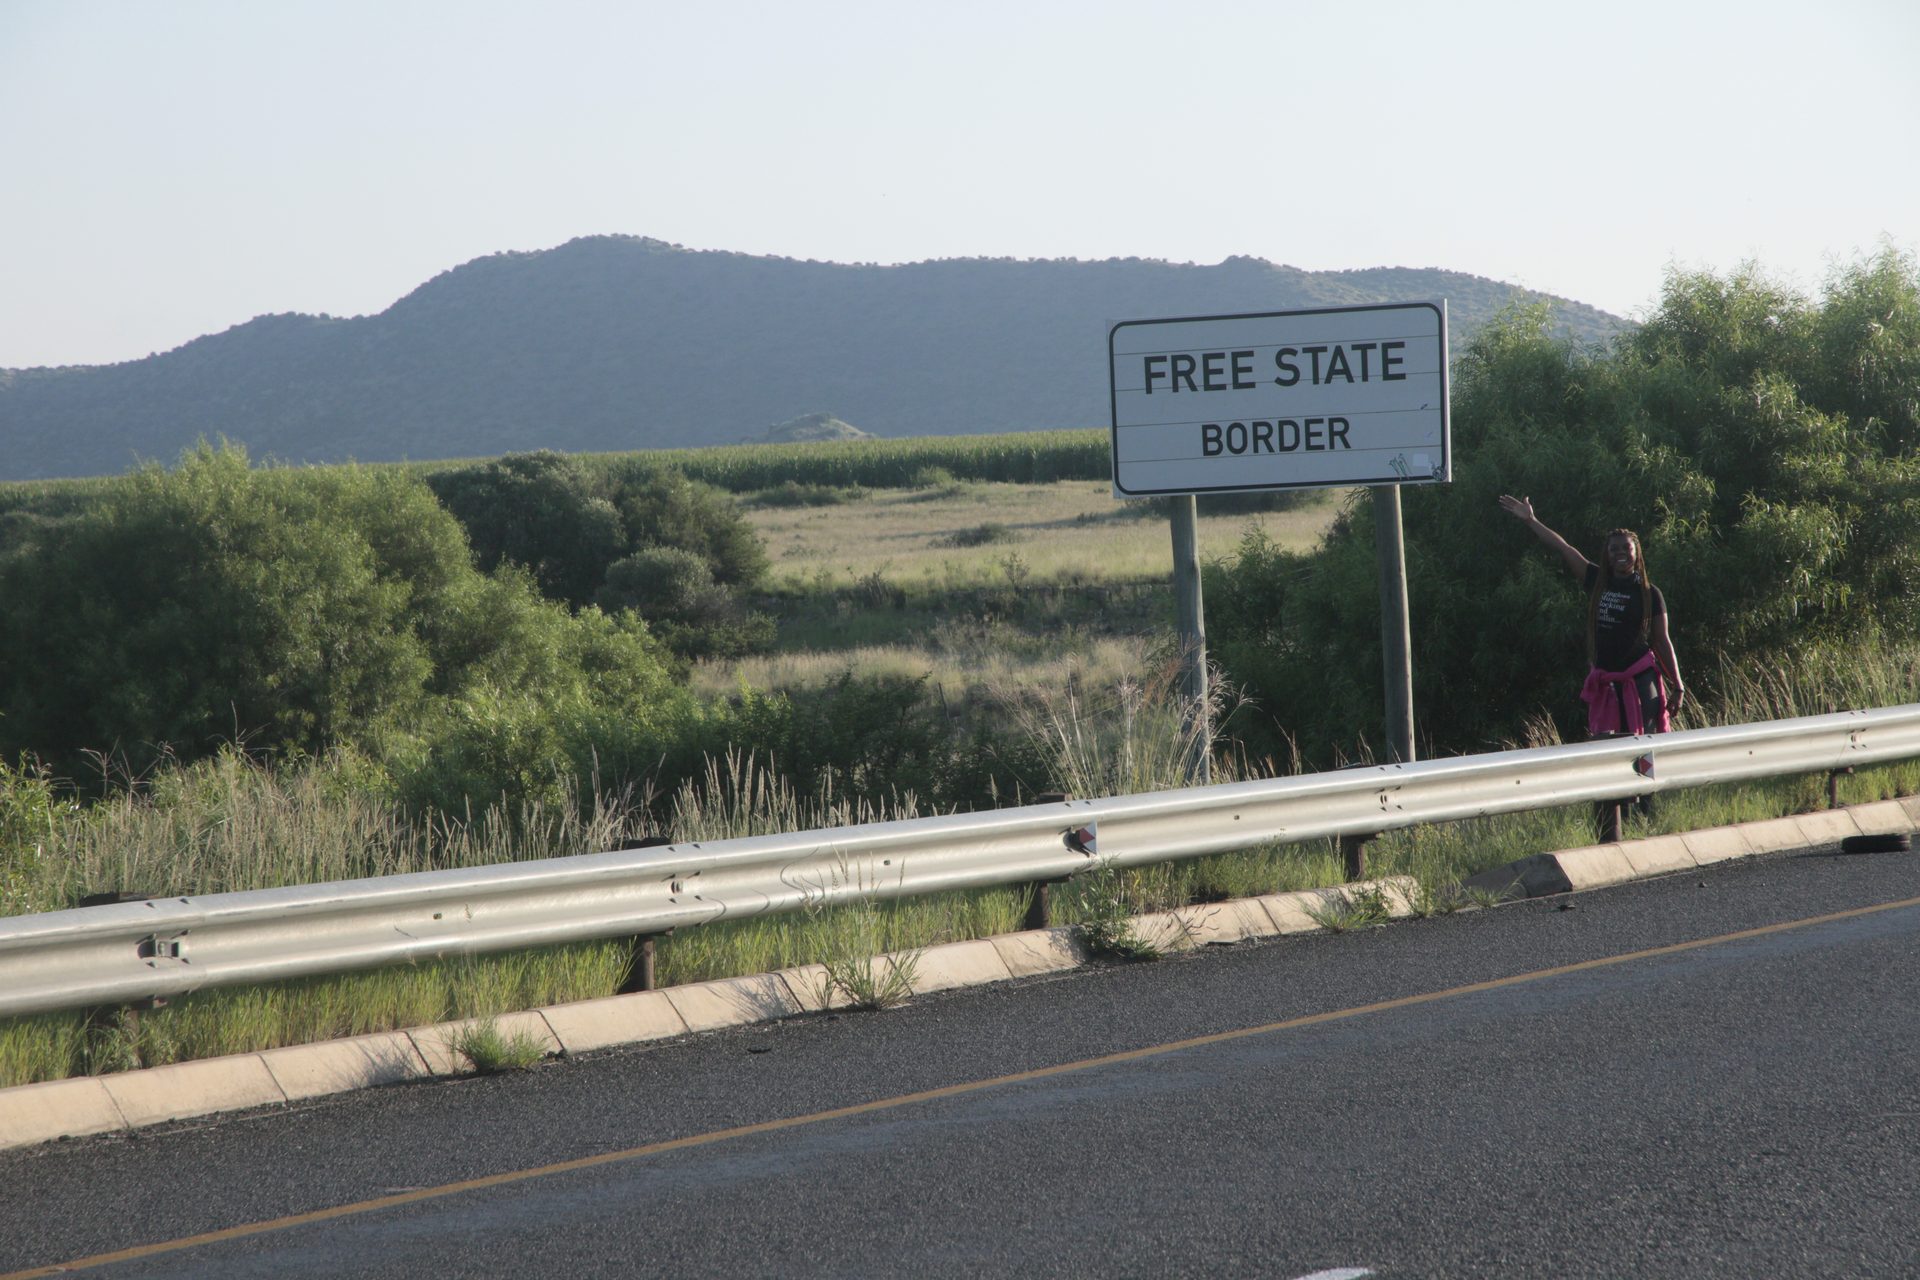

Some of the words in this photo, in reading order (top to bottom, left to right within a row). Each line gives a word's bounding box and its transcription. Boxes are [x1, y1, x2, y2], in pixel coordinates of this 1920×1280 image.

[1144, 351, 1257, 394] FREE
[1274, 341, 1407, 387] STATE
[1202, 417, 1351, 456] BORDER
